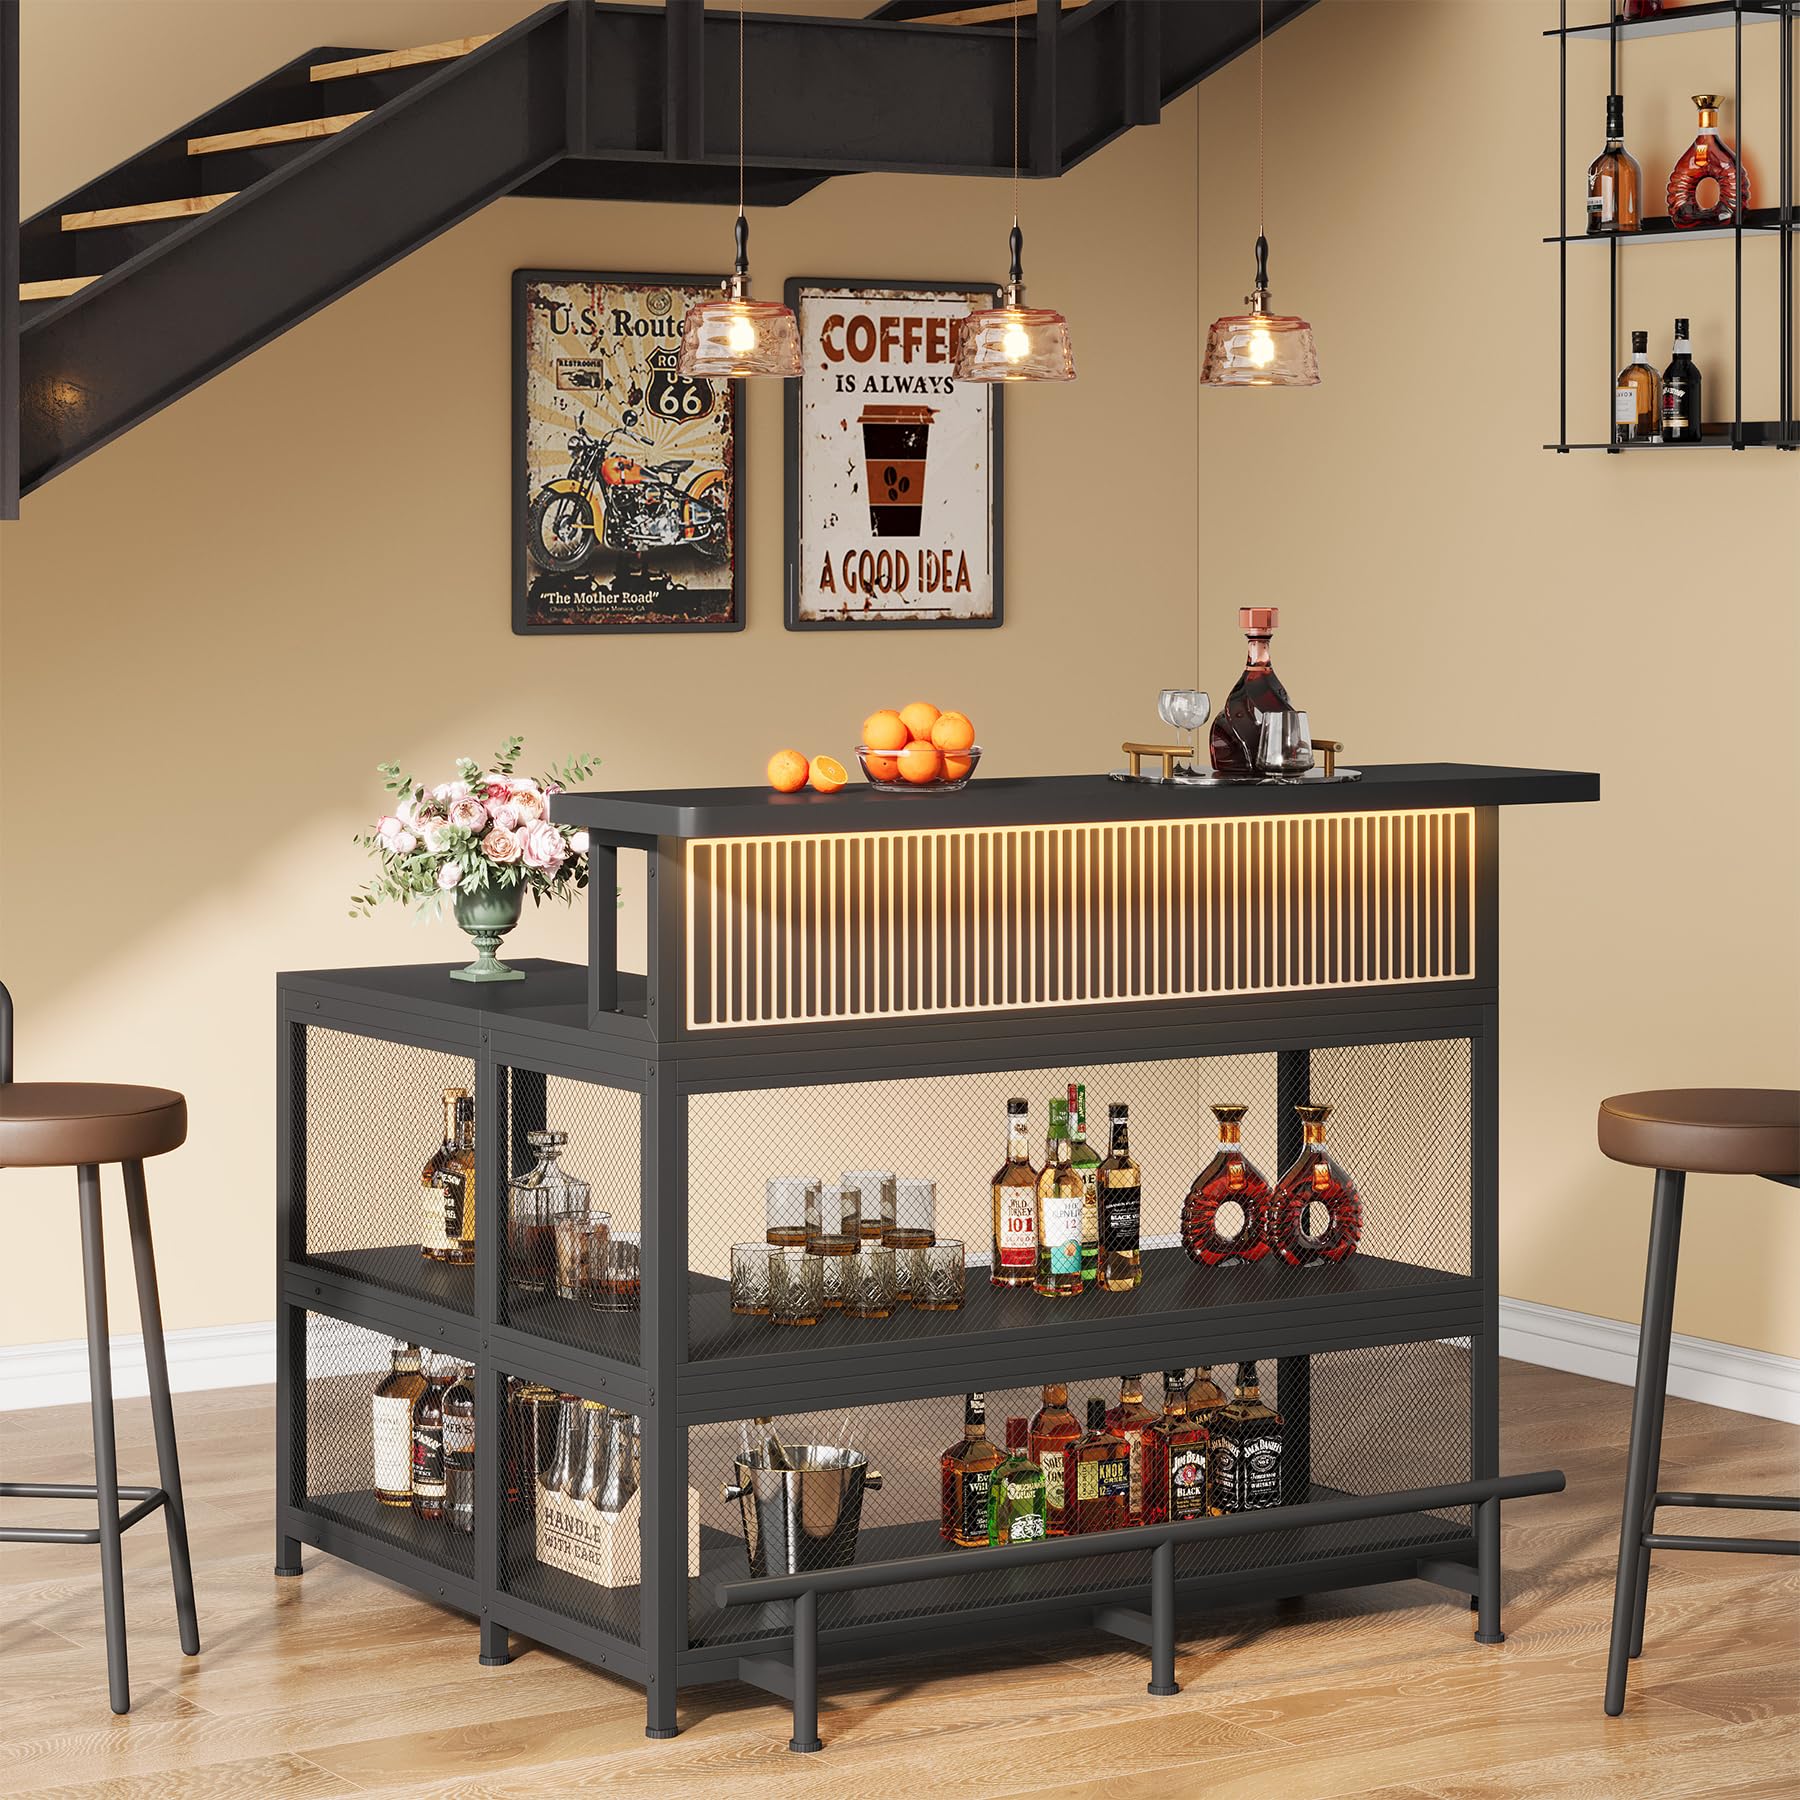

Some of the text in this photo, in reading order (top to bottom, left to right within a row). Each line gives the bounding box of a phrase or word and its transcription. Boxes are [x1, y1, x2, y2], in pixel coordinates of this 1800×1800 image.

[550, 308, 604, 336] U.S.
[836, 375, 954, 394] IS ALWAYS
[659, 386, 702, 415] 66
[819, 549, 971, 593] A GOOD IDEA
[574, 590, 620, 604] Mother
[1007, 1217, 1033, 1233] 101
[1066, 1218, 1077, 1229] 12
[1243, 1441, 1260, 1458] JACK
[1099, 1462, 1124, 1480] KNOB
[1172, 1453, 1186, 1474] JIM
[1186, 1450, 1206, 1469] BEAM
[1103, 1475, 1128, 1484] CREEK
[1176, 1486, 1201, 1498] BLACK
[544, 1507, 601, 1544] HANDLE
[544, 1533, 571, 1556] WITH
[574, 1544, 601, 1566] CARE
